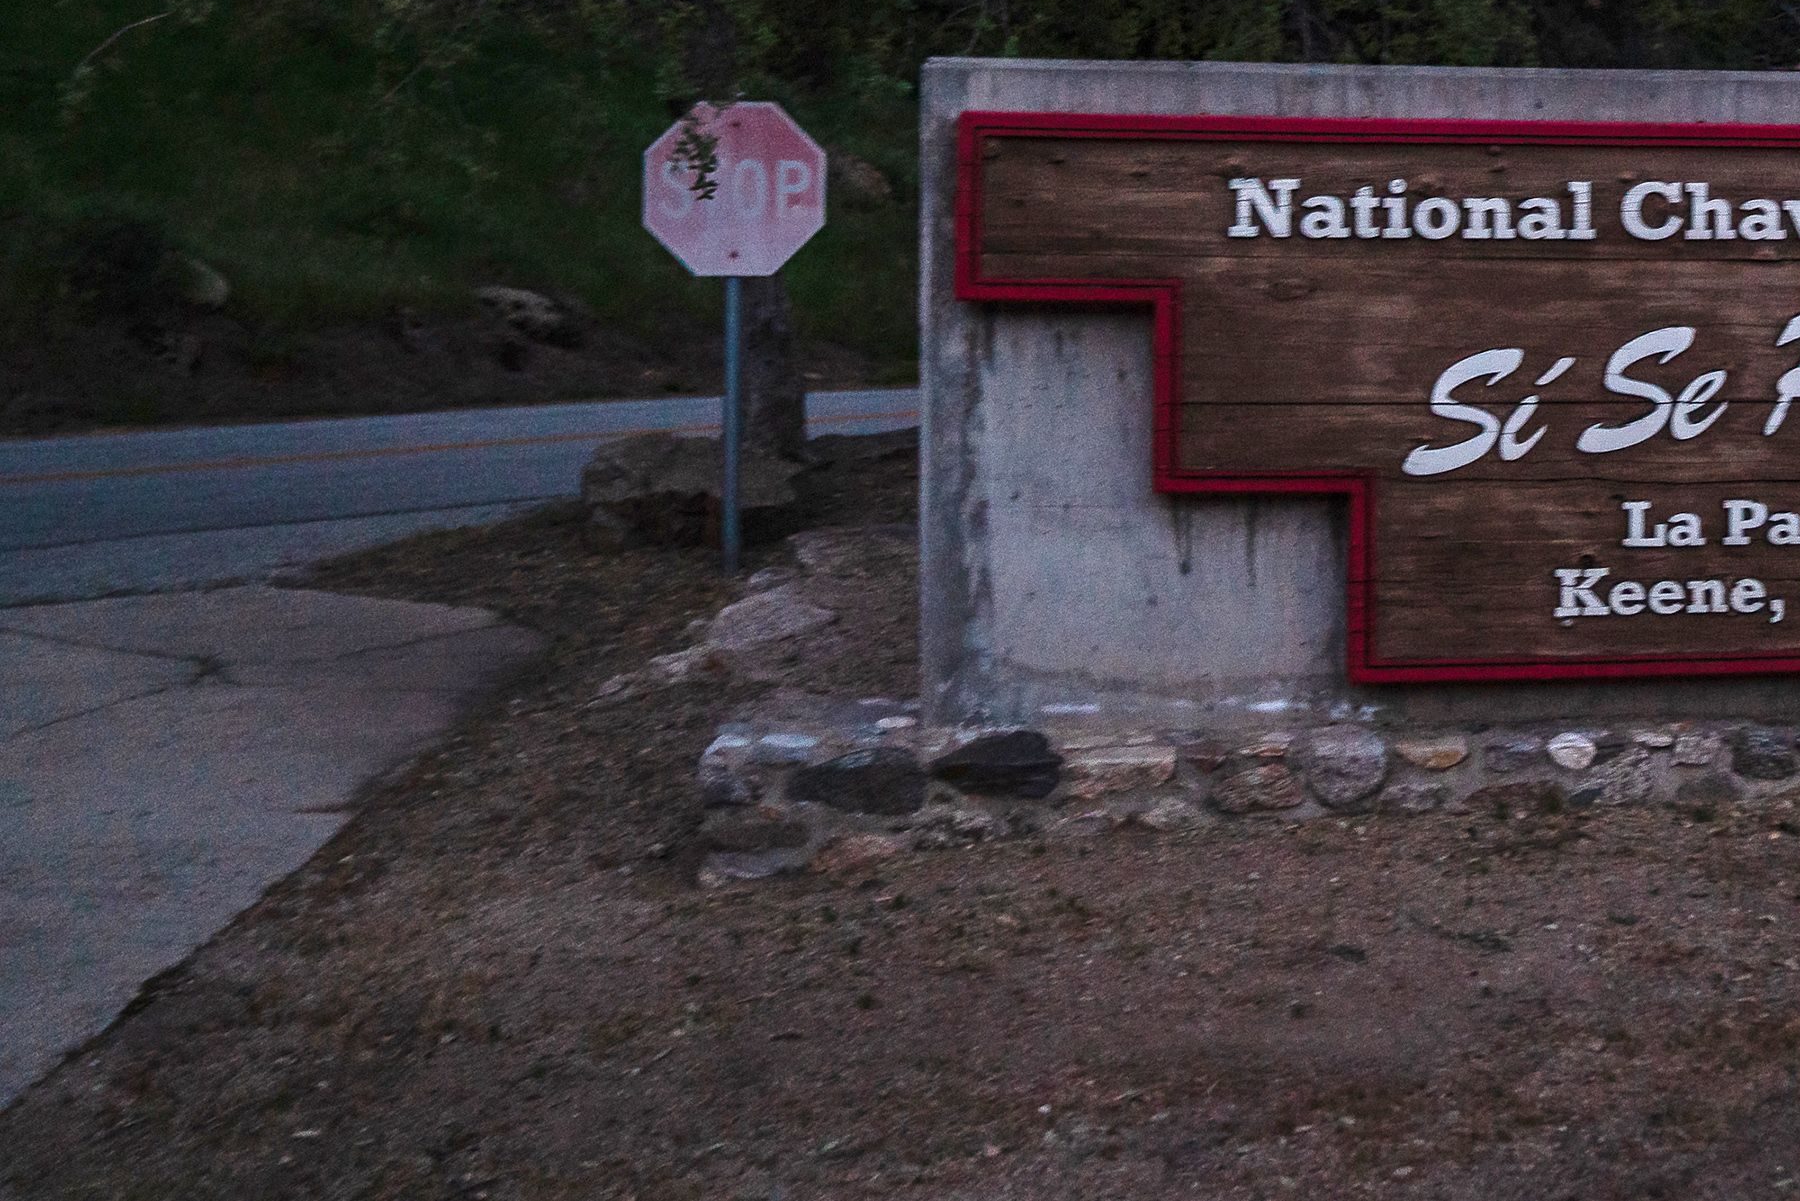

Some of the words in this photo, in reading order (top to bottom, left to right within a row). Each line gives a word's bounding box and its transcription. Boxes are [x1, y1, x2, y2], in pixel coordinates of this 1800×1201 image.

[659, 158, 811, 219] SOP
[1227, 178, 1597, 242] National
[1401, 347, 1576, 477] Sí
[1576, 326, 1729, 455] Se
[1621, 500, 1706, 548] La
[1553, 566, 1785, 624] Keene,
